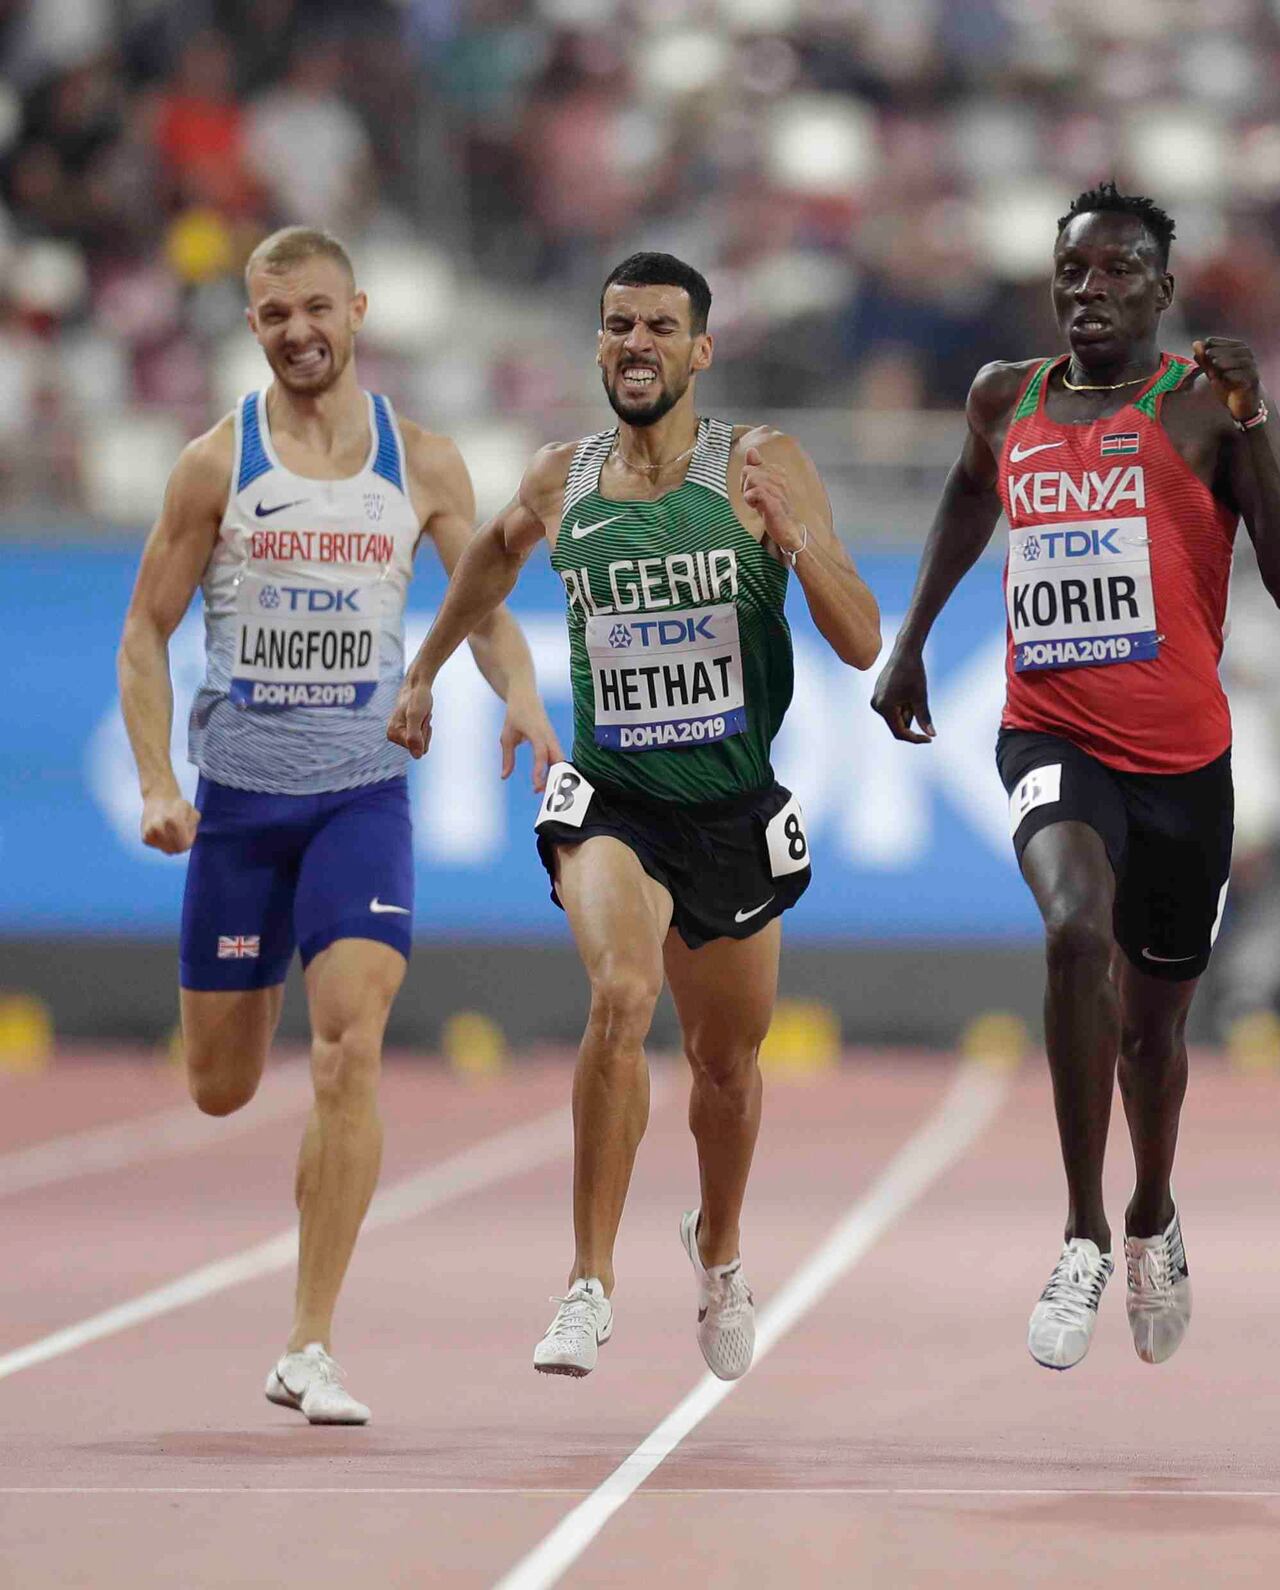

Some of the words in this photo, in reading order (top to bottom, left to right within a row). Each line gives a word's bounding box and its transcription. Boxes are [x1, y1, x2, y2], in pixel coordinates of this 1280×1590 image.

[1007, 465, 1146, 518] KENYA
[250, 530, 318, 561] GREAT
[319, 532, 395, 564] BRITAIN
[1039, 527, 1122, 559] TDK
[281, 586, 361, 612] TDK
[559, 548, 739, 622] ALGERIA
[1012, 575, 1141, 630] KORIR
[240, 624, 373, 670] LANGFORD
[630, 614, 717, 648] TDK
[1022, 637, 1132, 666] DOHA2019
[252, 683, 357, 706] DOHA2019
[599, 655, 733, 712] HETHAT
[619, 717, 726, 748] DOHA2019
[784, 812, 807, 861] 8
